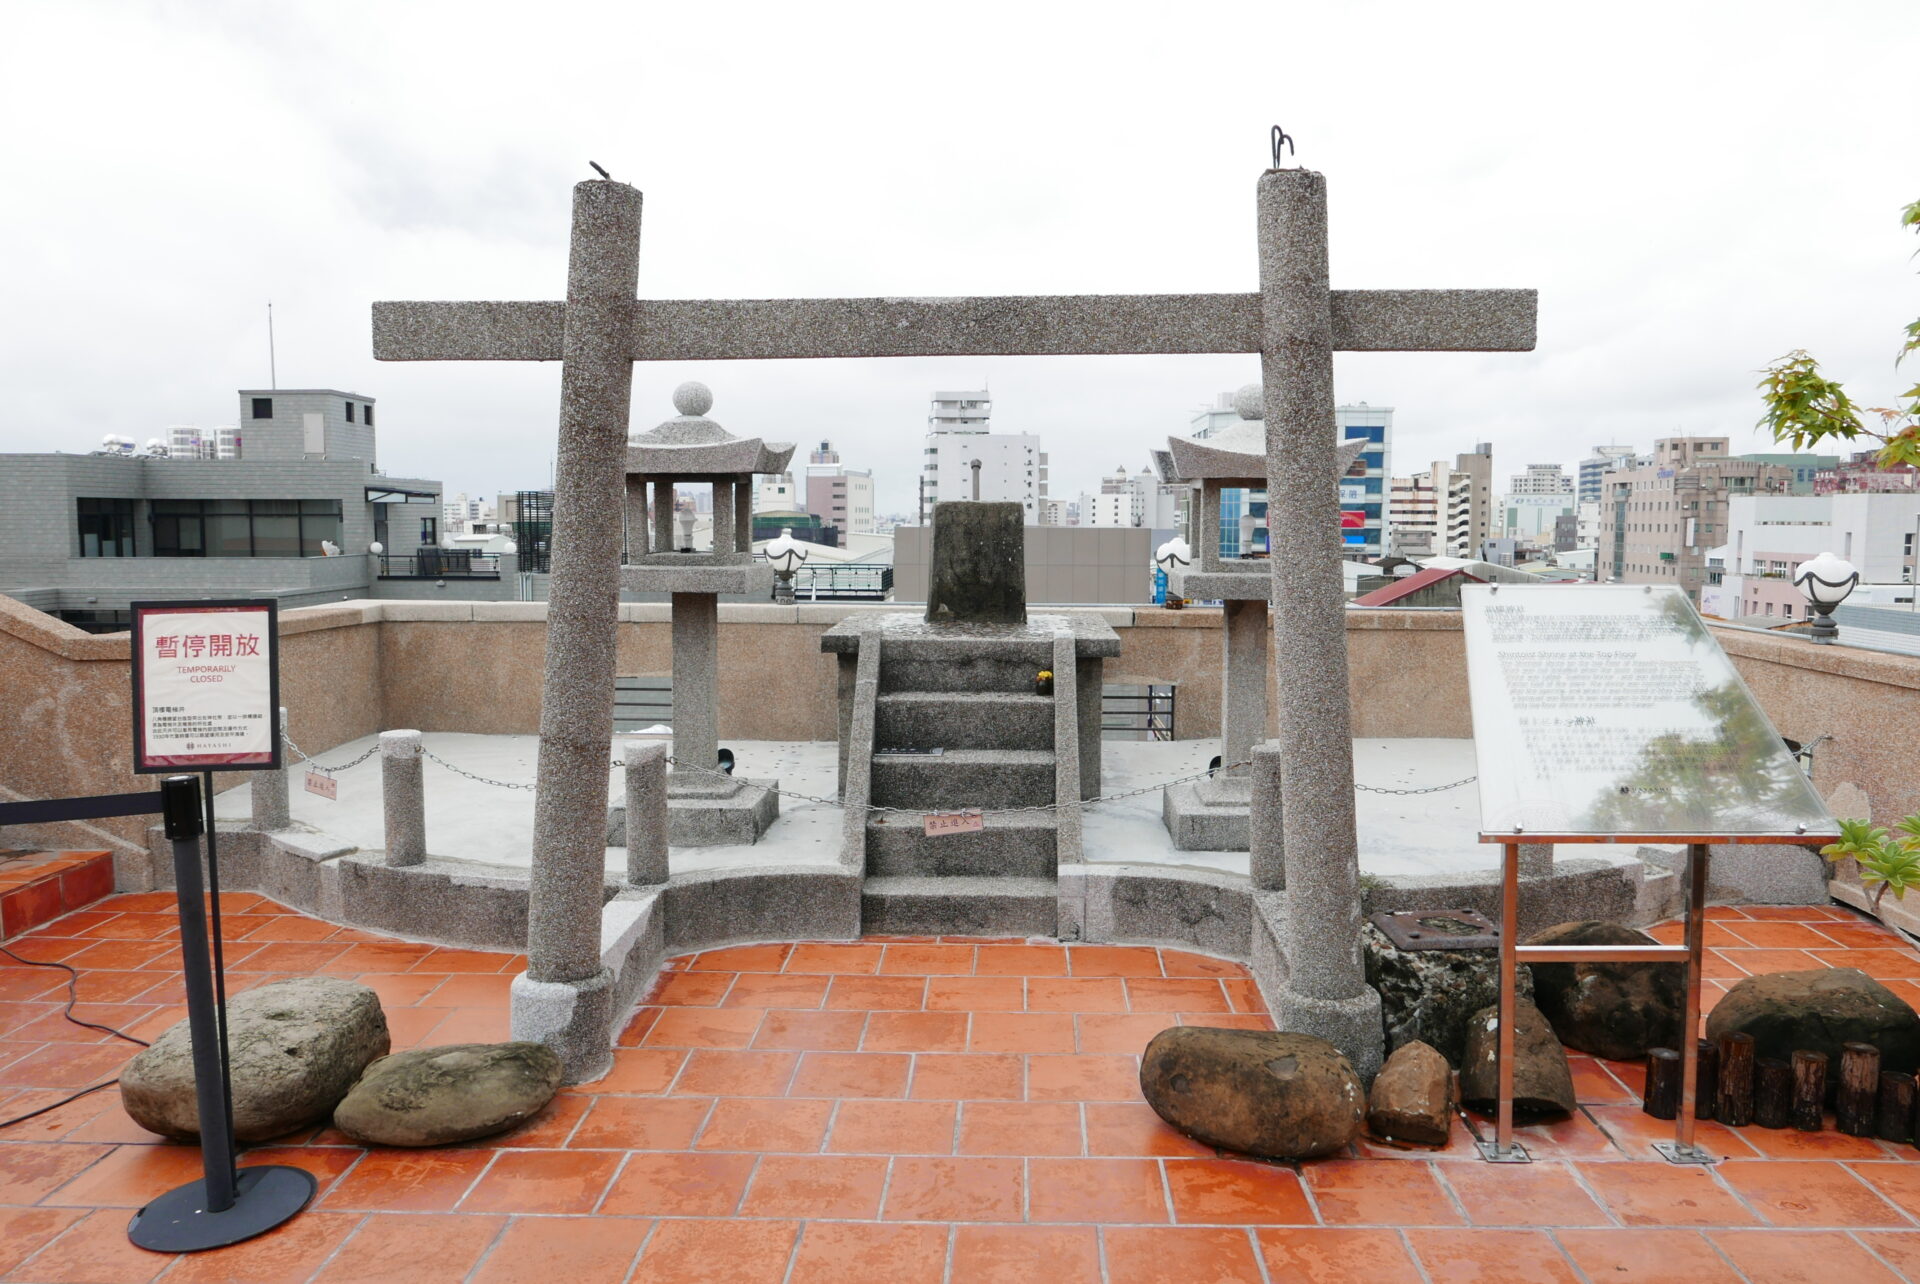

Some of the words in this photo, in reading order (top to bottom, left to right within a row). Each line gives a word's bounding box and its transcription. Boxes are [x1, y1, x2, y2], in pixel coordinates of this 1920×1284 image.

[155, 633, 260, 658] 暫停開放
[1595, 651, 1612, 659] Top
[177, 665, 236, 674] TEMPORARILY
[190, 675, 223, 683] CLOSED
[929, 816, 969, 829] 禁止進入
